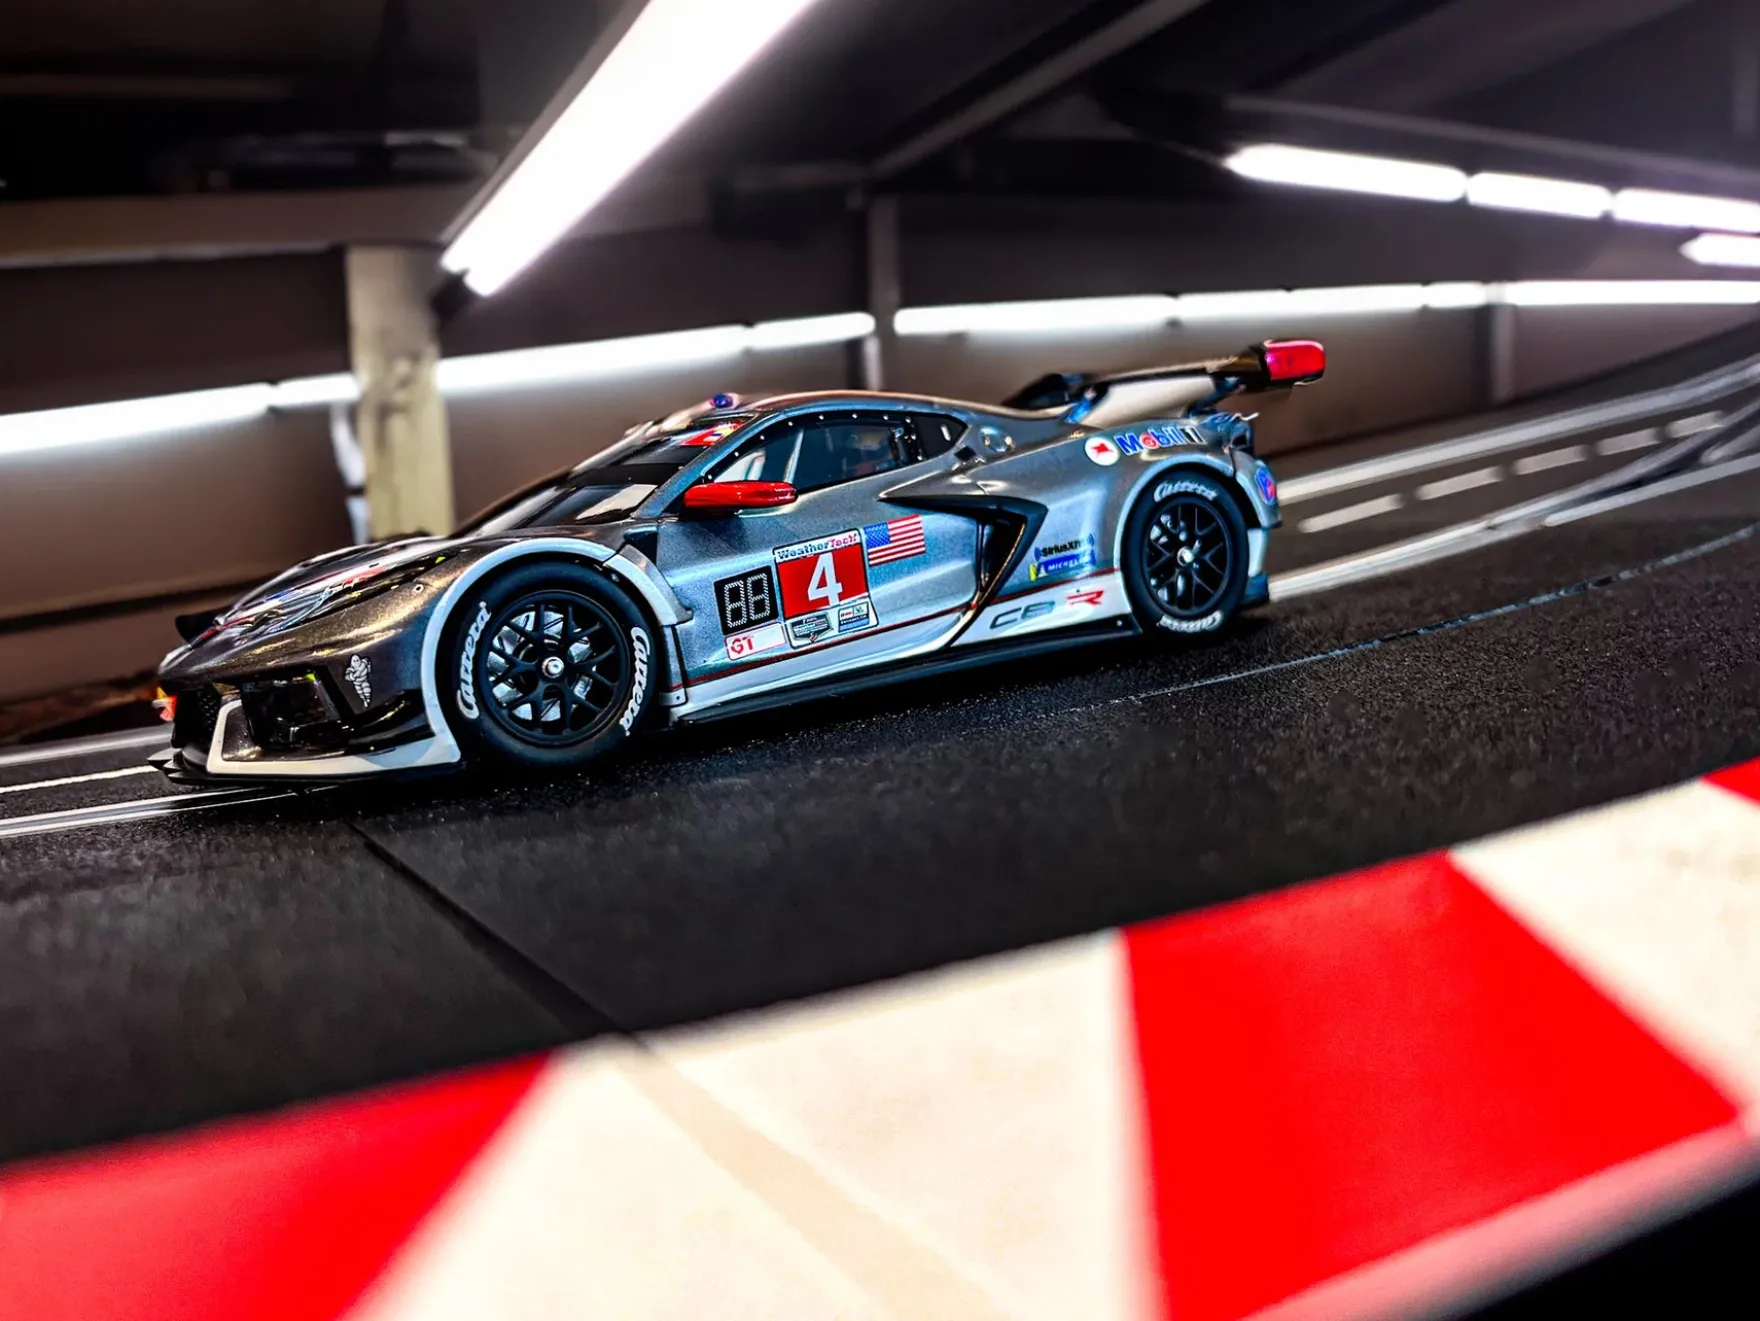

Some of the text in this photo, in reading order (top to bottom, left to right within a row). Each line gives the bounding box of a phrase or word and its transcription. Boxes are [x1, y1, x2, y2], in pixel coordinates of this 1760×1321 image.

[1113, 426, 1188, 456] Mobil
[777, 533, 858, 560] WeatherTech
[723, 572, 771, 629] 88
[807, 551, 843, 607] 4
[456, 601, 492, 720] Carrera
[730, 635, 755, 655] GT
[618, 626, 650, 737] Carrera
